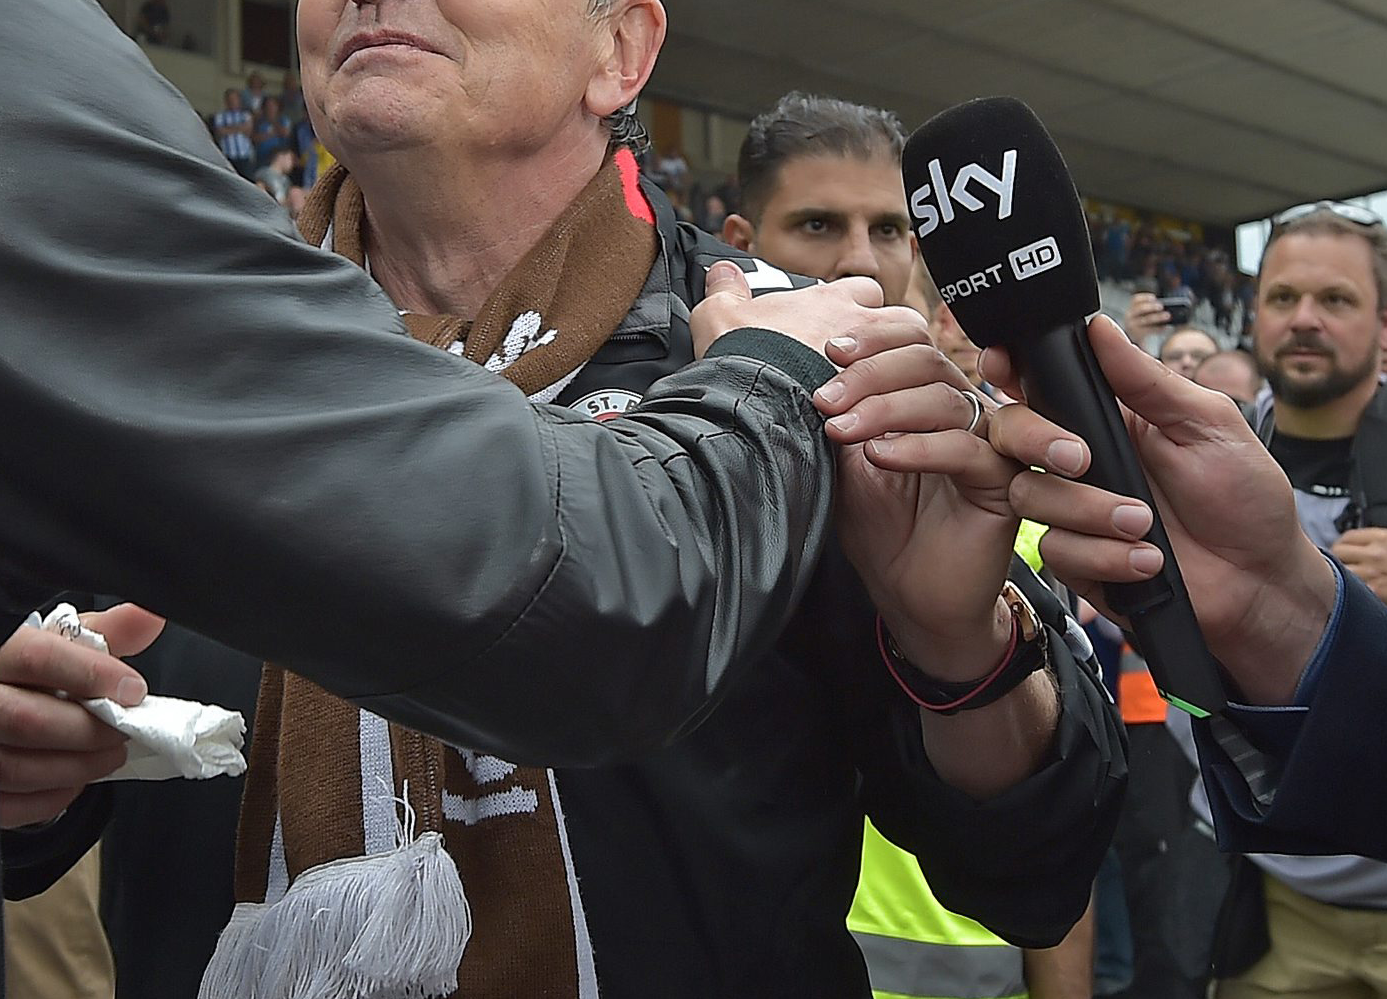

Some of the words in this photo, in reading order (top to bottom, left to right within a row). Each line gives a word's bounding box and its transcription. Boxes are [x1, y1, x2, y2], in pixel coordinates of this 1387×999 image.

[910, 149, 1017, 238] sky
[941, 263, 1002, 304] SPORT
[1014, 243, 1056, 275] HD
[587, 396, 618, 414] ST.
